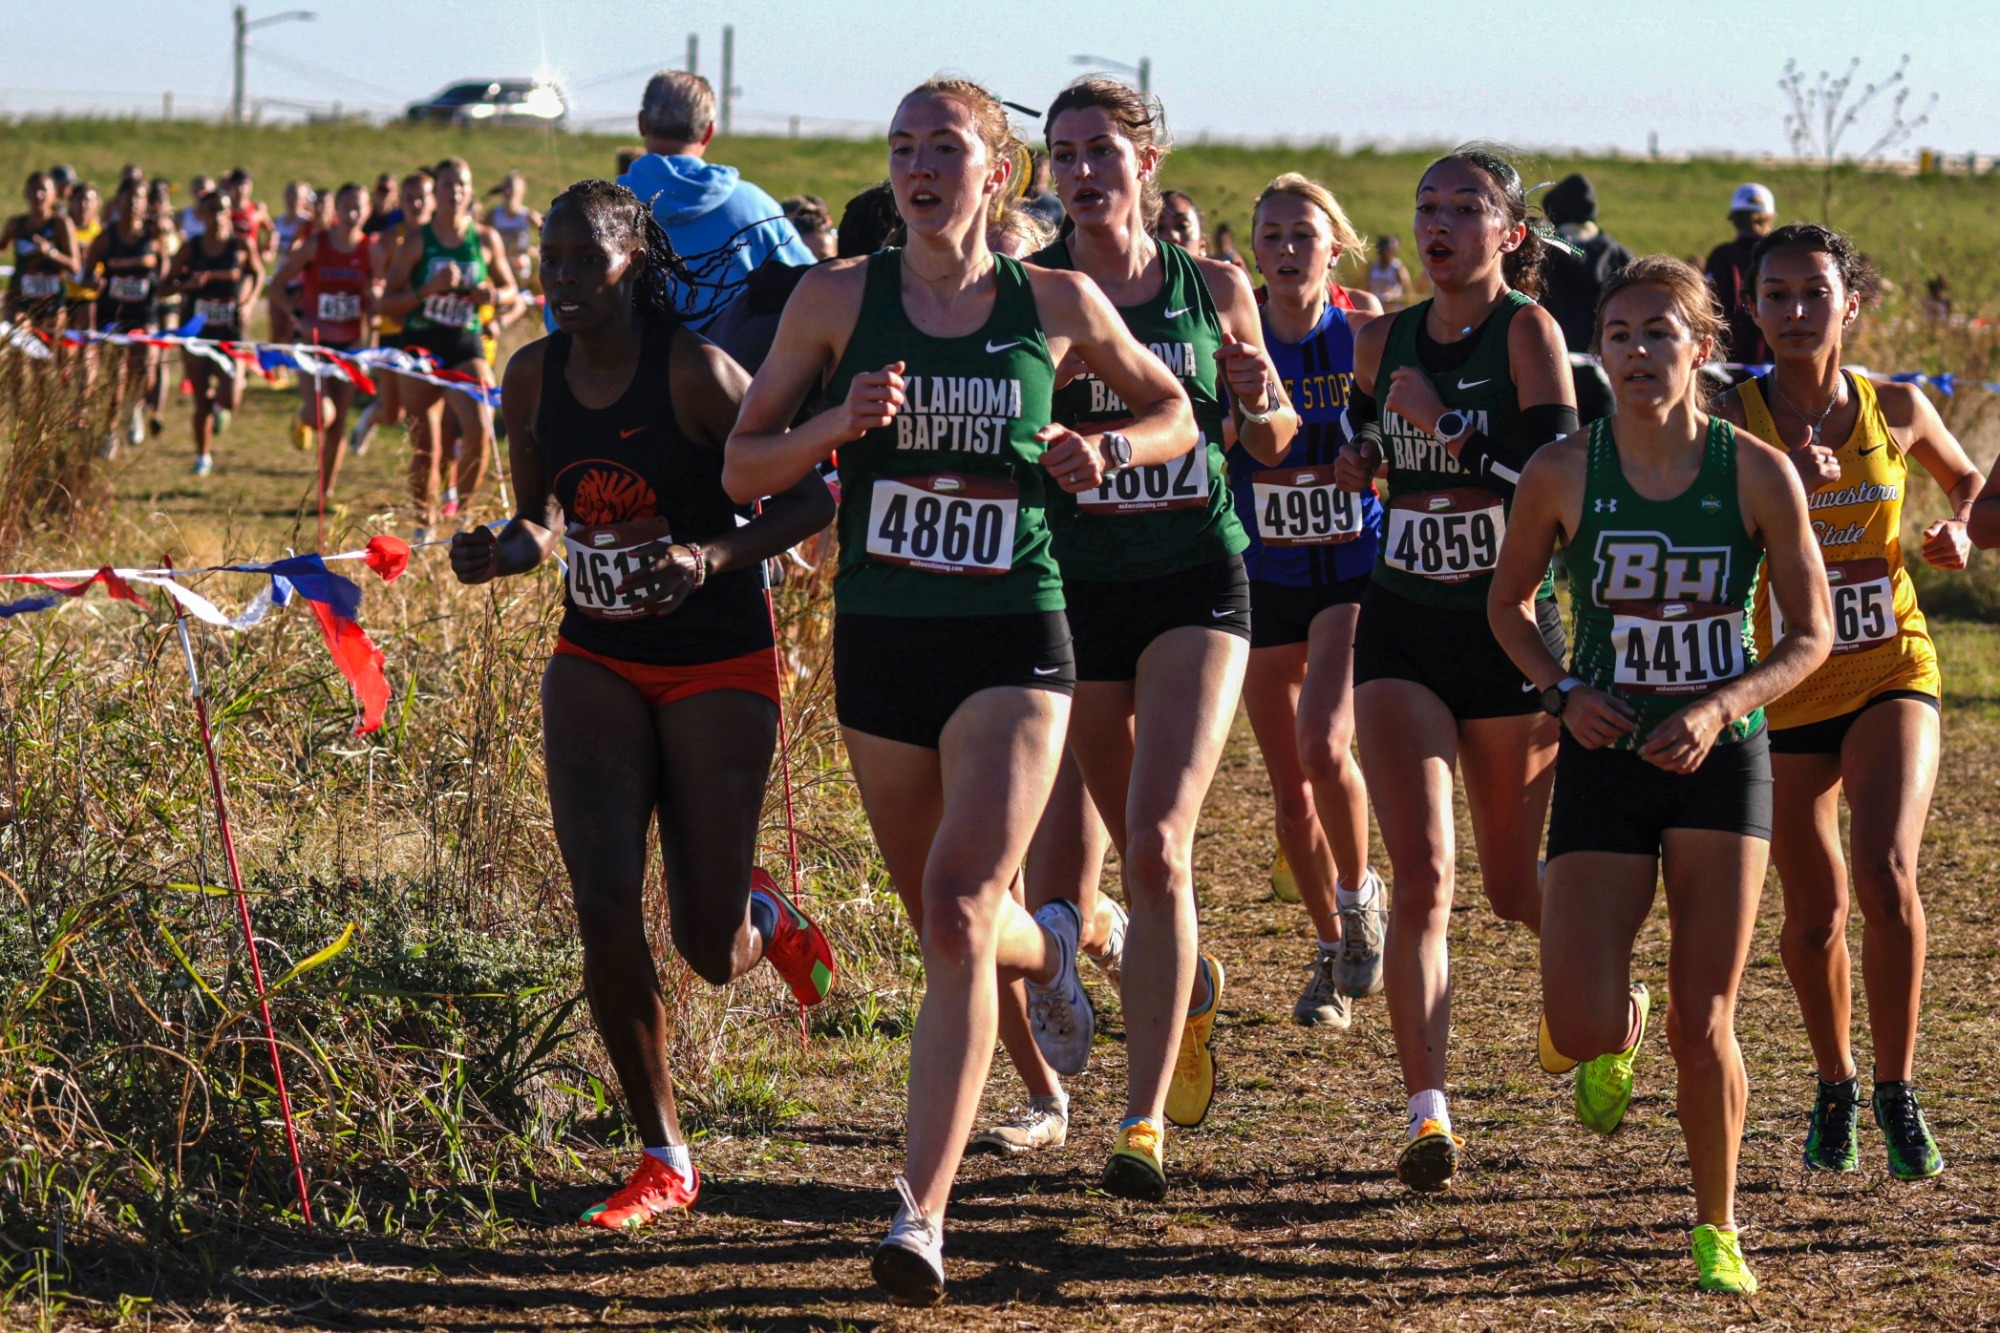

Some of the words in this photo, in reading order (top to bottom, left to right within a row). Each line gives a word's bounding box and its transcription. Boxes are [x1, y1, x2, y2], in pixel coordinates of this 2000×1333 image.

[902, 376, 1022, 418] KLAHOMA
[896, 415, 1007, 455] BAPTIST
[1392, 436, 1471, 475] BAPTIS
[879, 494, 1003, 565] 4860
[1264, 487, 1354, 537] 4999
[1811, 520, 1866, 546] State
[1394, 513, 1497, 572] 4859
[575, 550, 661, 607] 461
[1603, 543, 1720, 602] BH
[1624, 618, 1734, 682] 4410
